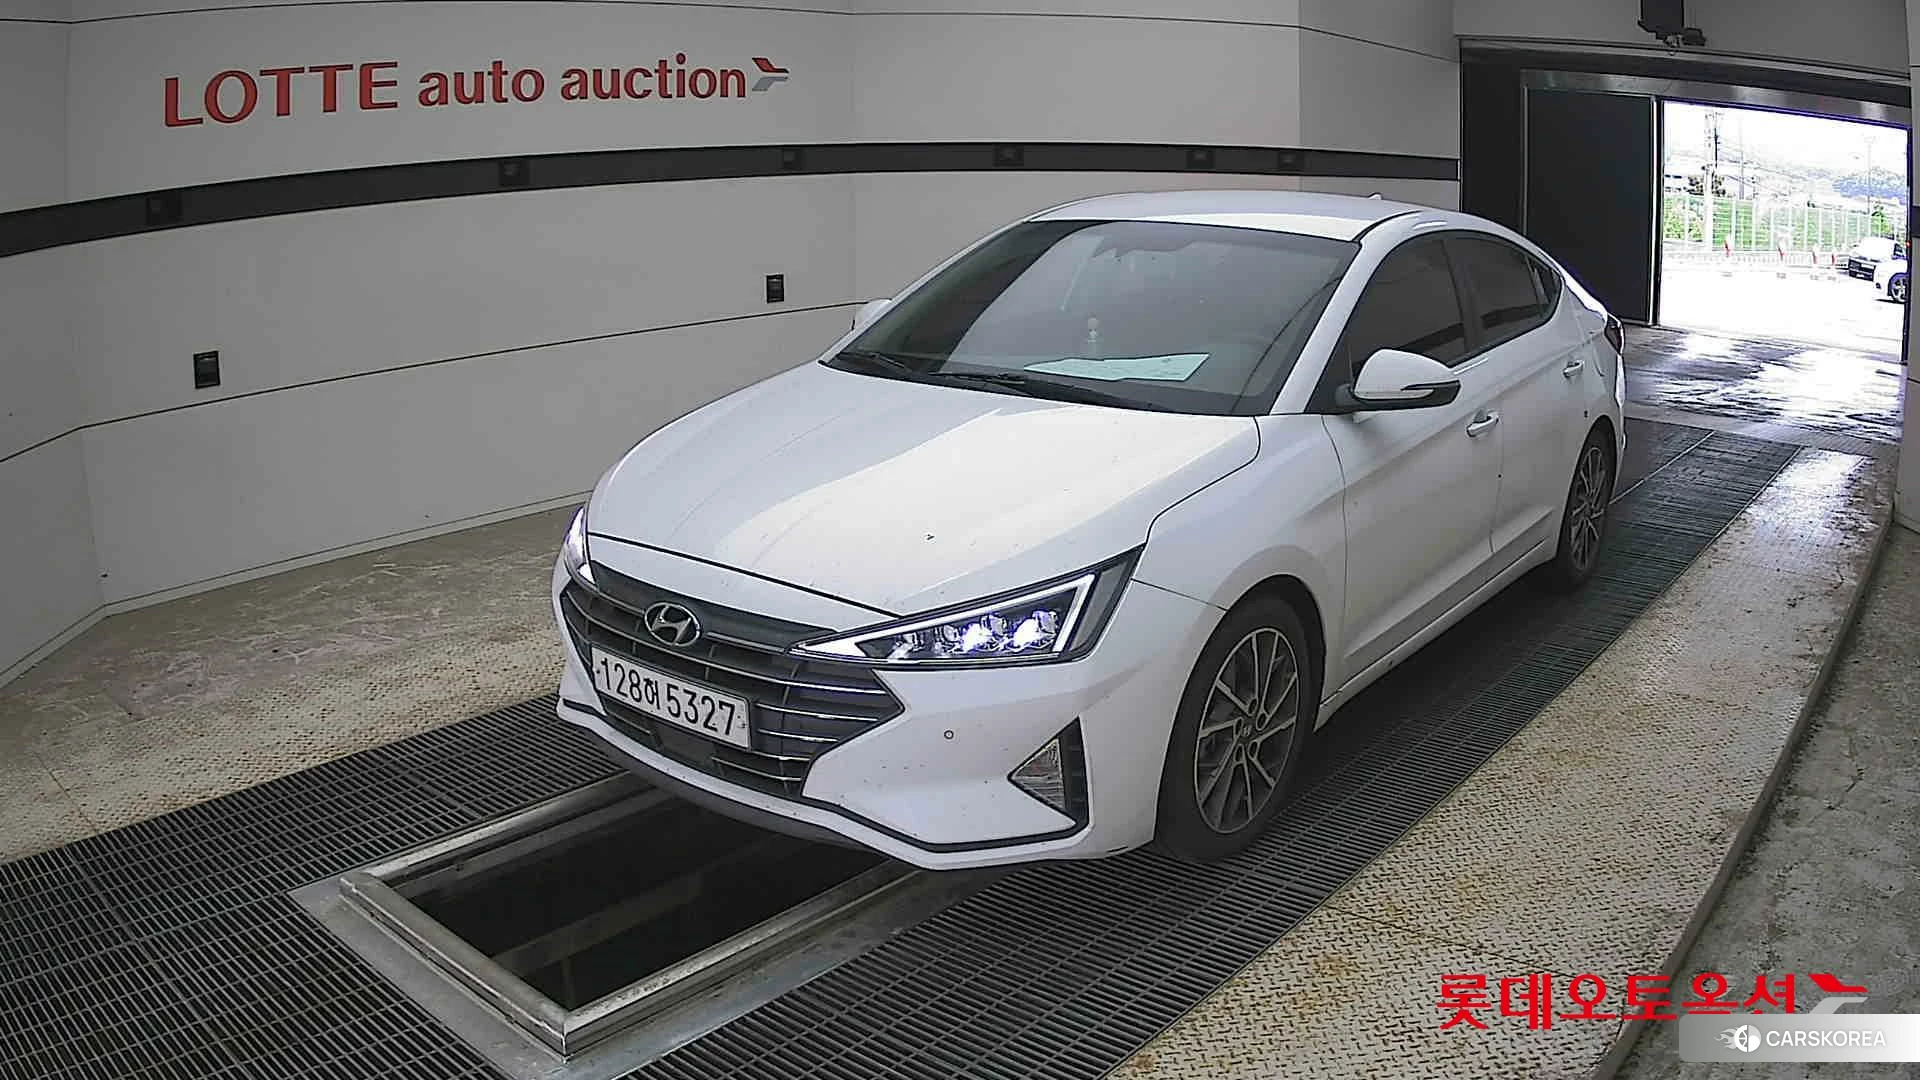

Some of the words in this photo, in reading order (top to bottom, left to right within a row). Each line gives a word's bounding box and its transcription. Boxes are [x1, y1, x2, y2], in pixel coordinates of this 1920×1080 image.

[165, 61, 399, 127] LOTTE
[417, 60, 545, 107] auto
[560, 52, 747, 100] auction
[666, 683, 736, 736] 5327
